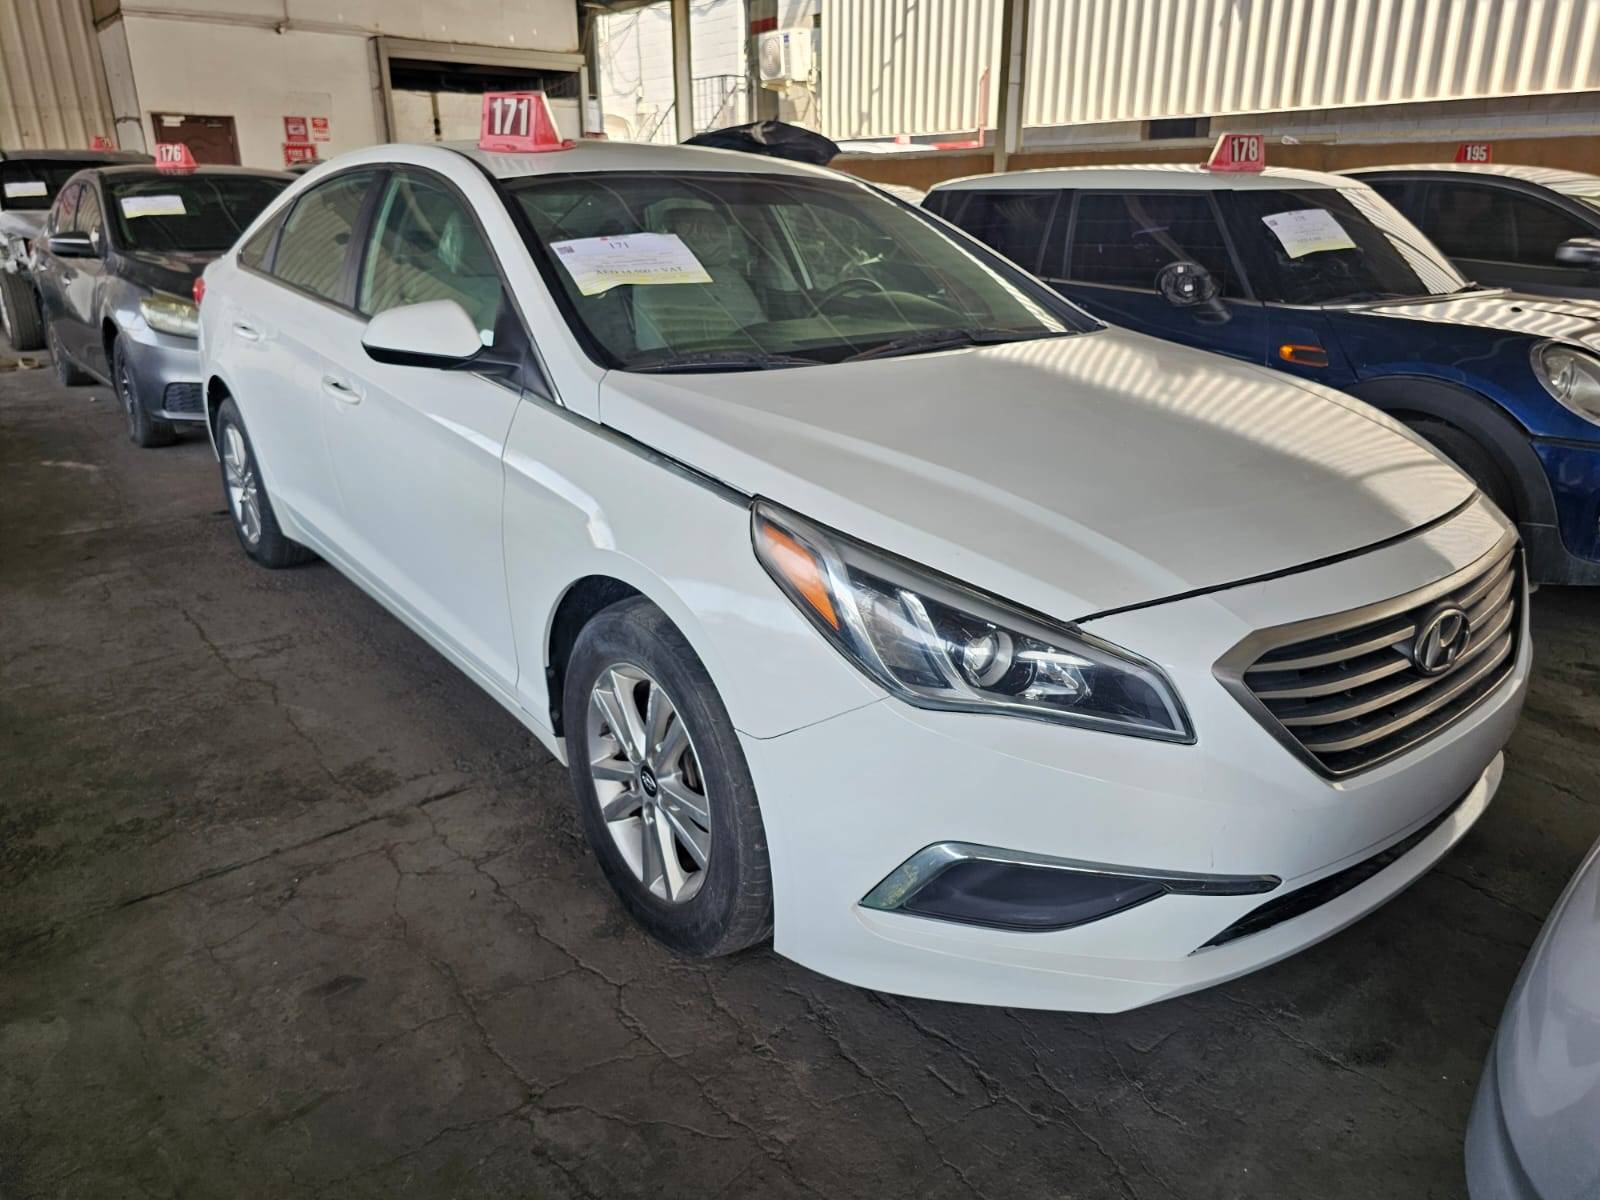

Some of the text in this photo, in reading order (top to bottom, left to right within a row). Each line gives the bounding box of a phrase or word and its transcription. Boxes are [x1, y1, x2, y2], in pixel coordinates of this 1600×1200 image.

[491, 97, 529, 136] 171
[160, 144, 182, 162] 176
[1232, 137, 1258, 162] 178
[1466, 145, 1487, 162] 195
[608, 241, 630, 249] 171
